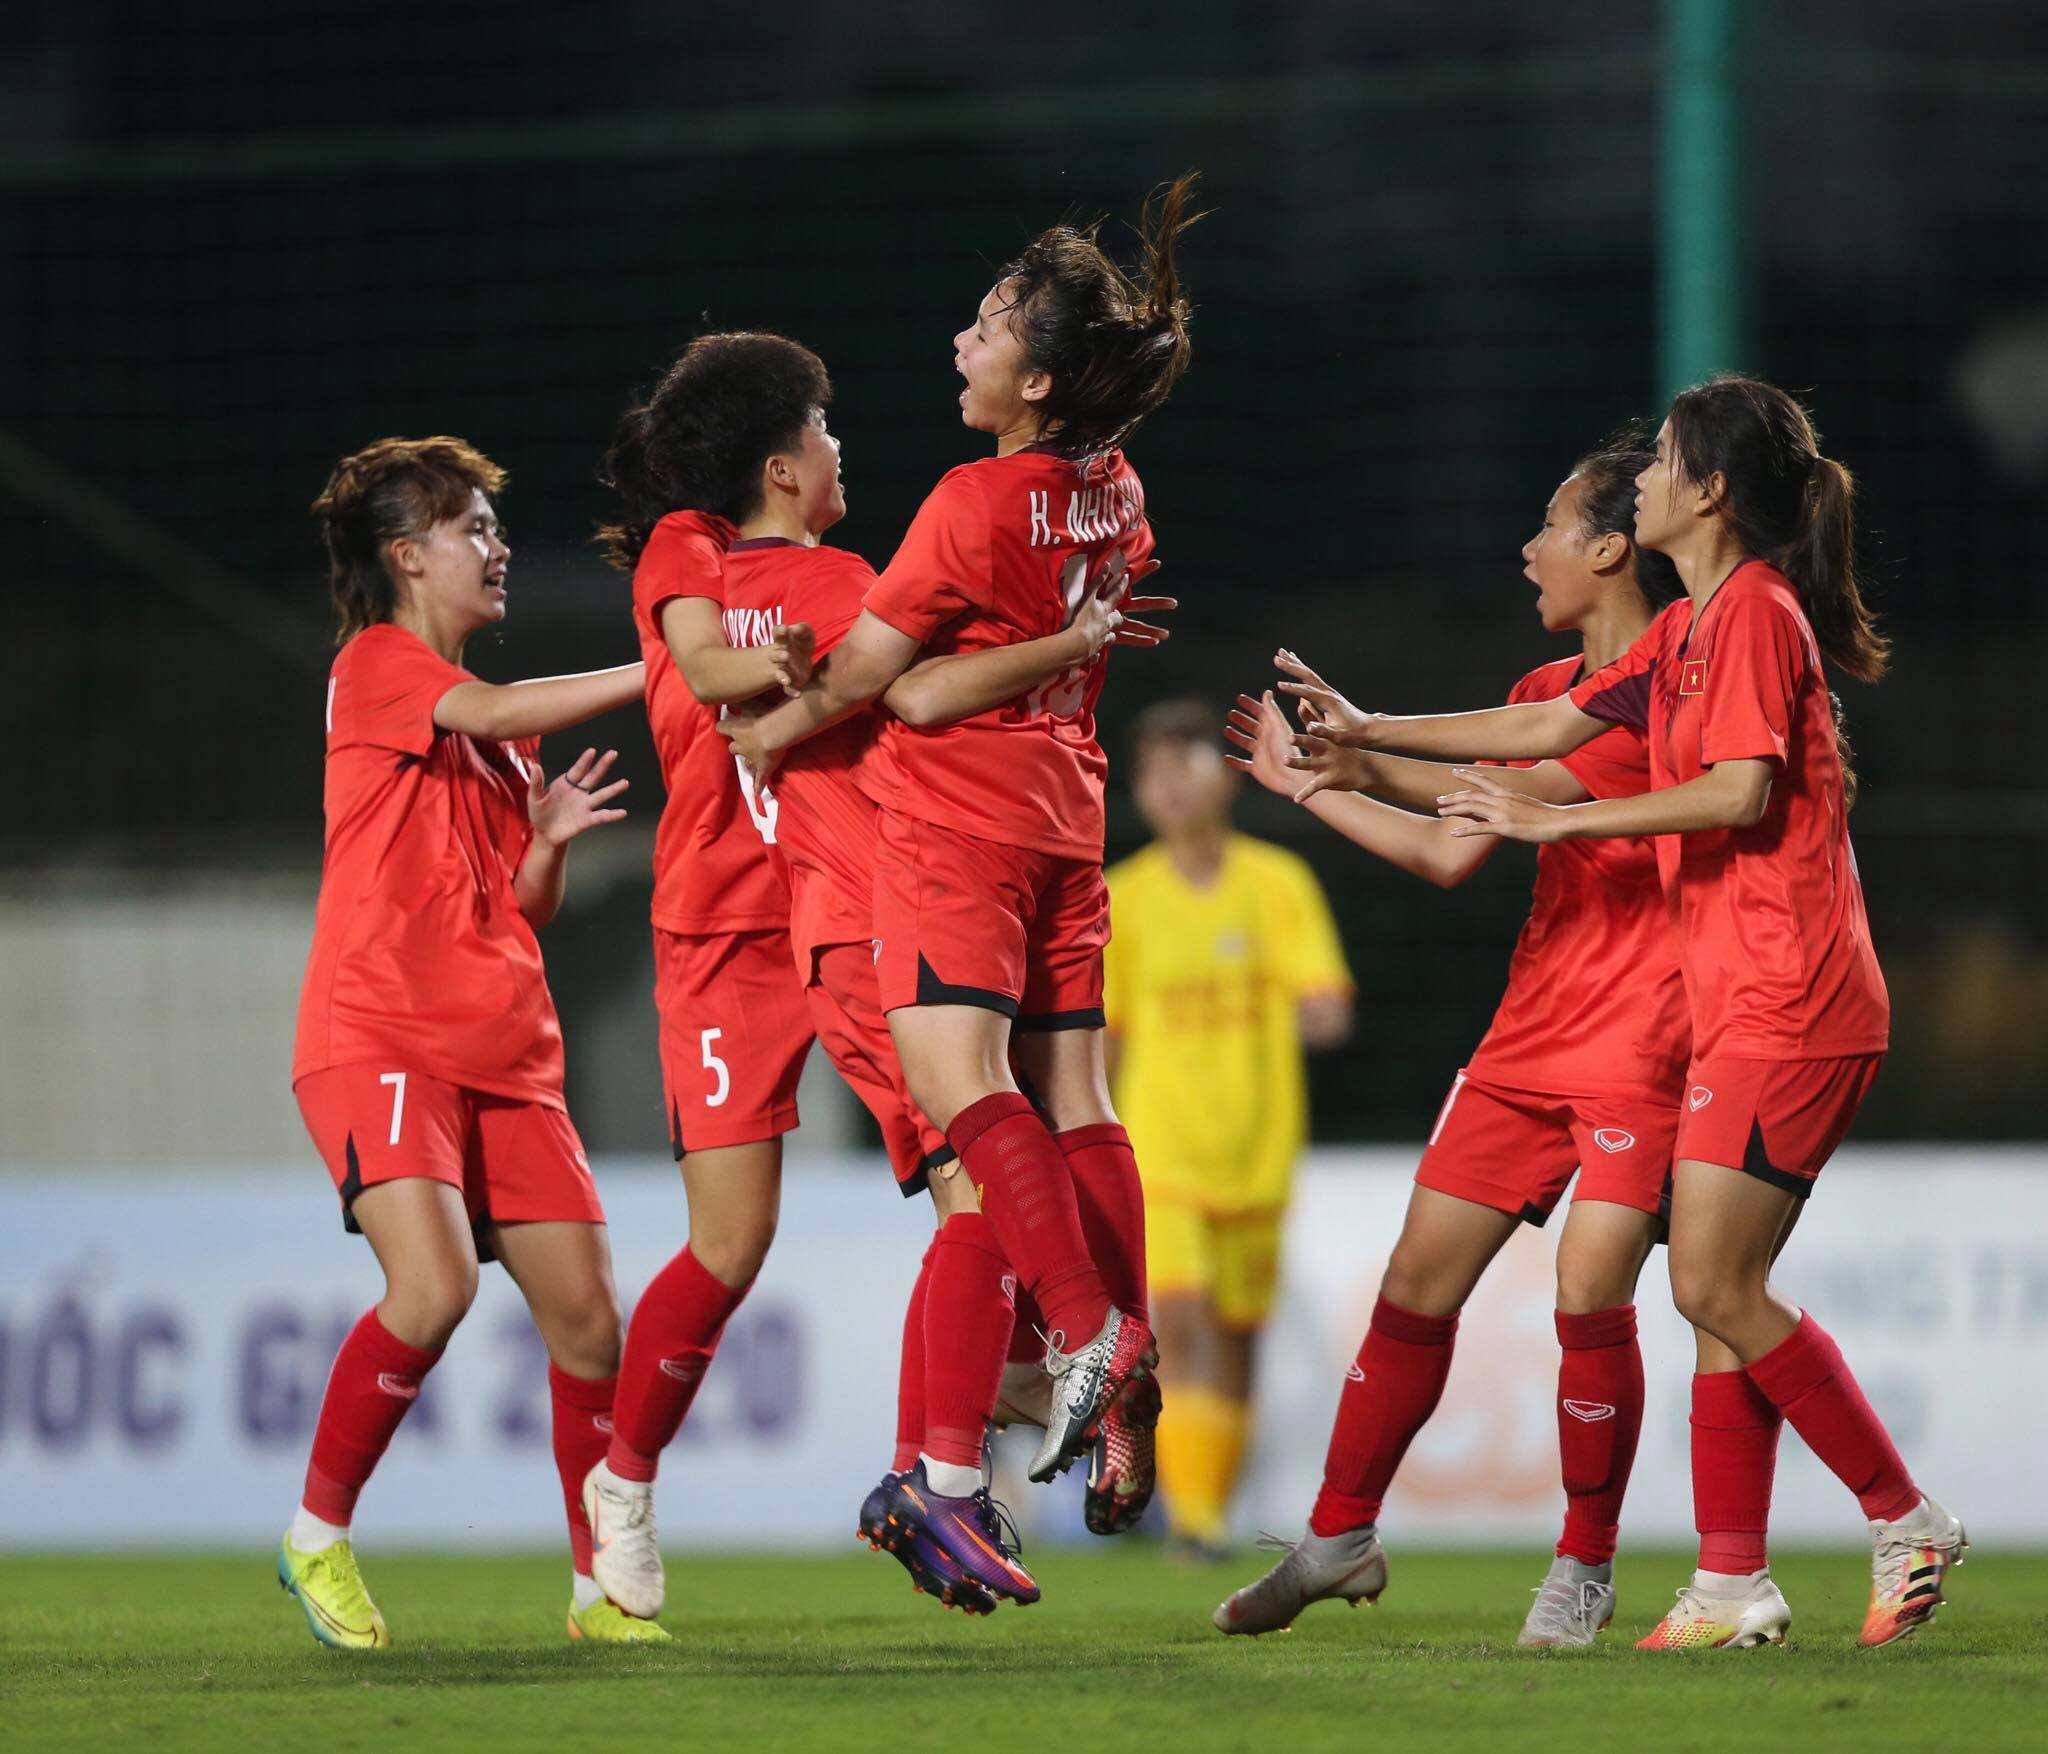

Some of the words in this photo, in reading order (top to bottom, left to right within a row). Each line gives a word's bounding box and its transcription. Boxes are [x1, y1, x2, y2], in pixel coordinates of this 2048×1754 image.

[1029, 490, 1061, 547] H.
[701, 1026, 731, 1108] 5
[379, 1070, 407, 1146] 7
